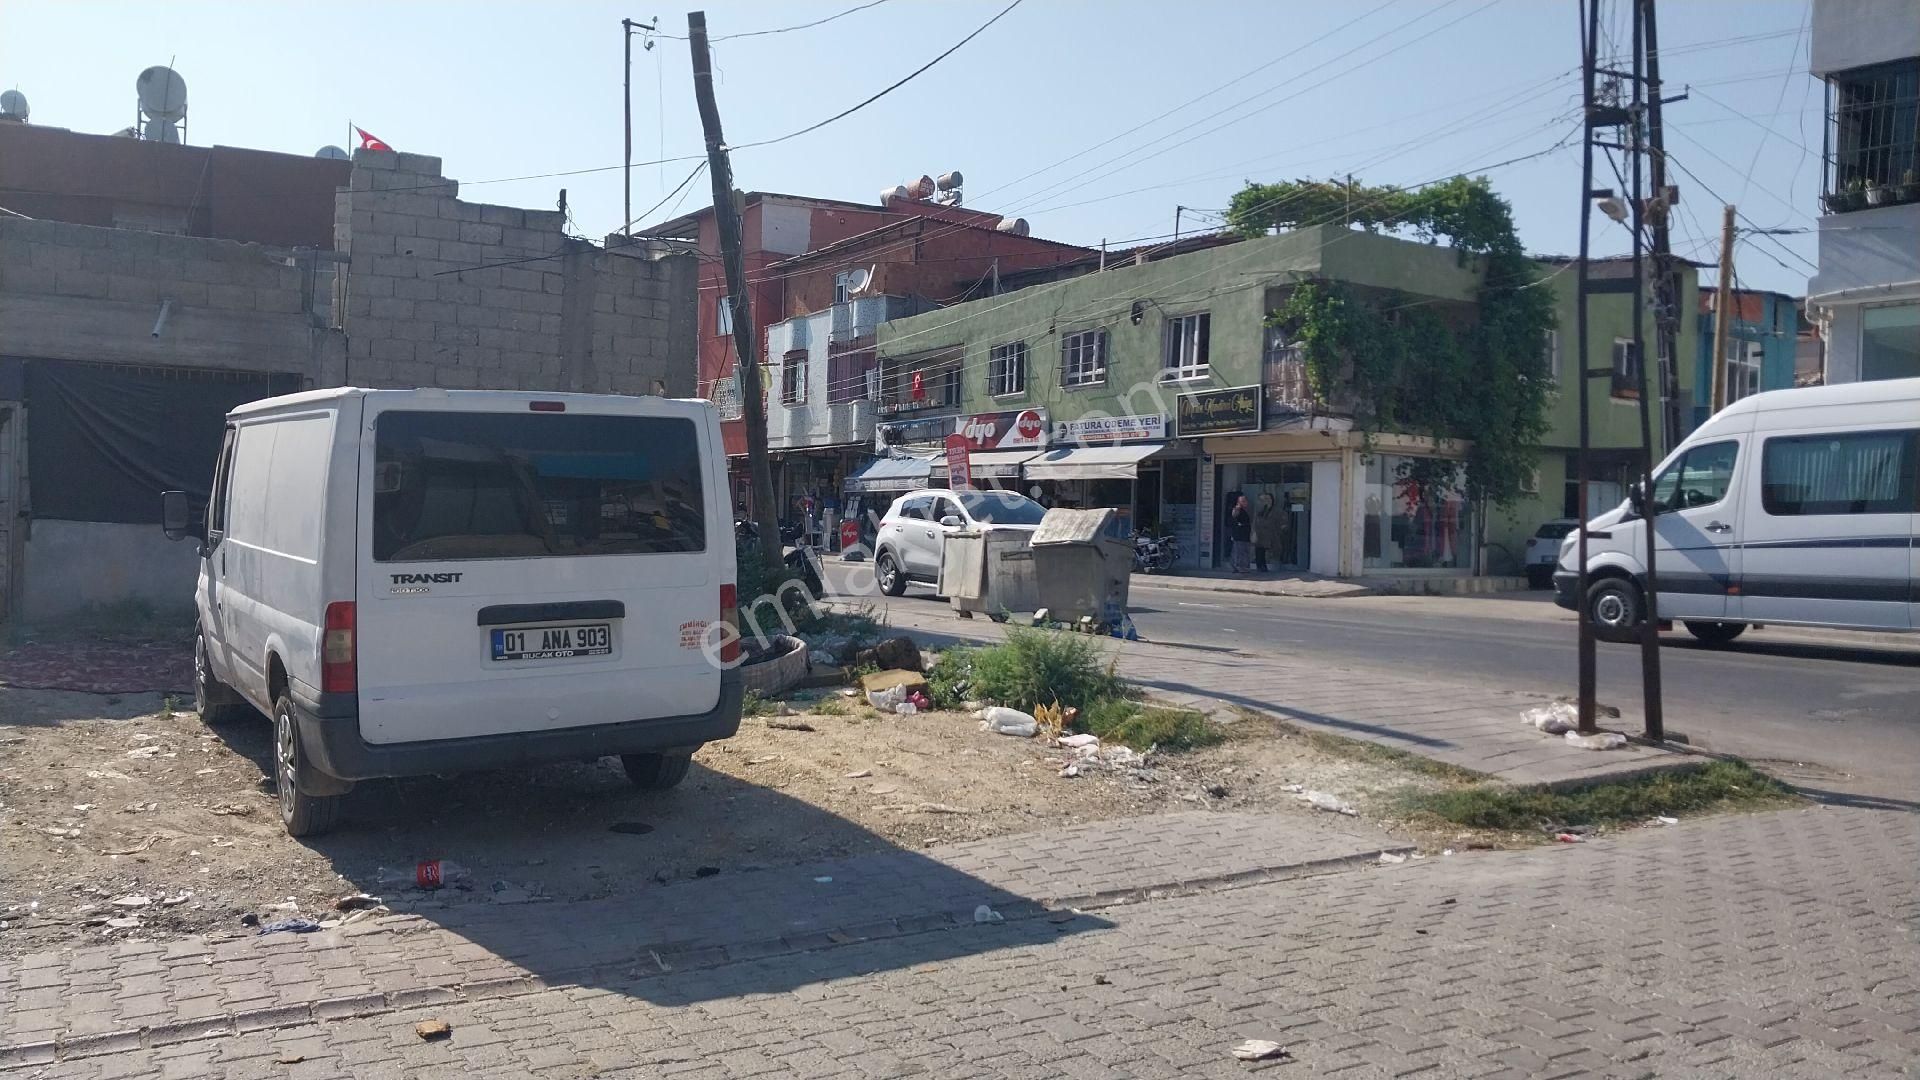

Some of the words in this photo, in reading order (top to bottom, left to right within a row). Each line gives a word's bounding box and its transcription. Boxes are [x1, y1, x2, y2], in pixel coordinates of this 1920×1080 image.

[1020, 416, 1041, 430] dyo
[1069, 420, 1101, 431] FATURA
[965, 418, 996, 444] dyo
[390, 572, 463, 584] TRANSIT
[505, 632, 525, 651] 01
[542, 630, 572, 650] ANA
[577, 628, 607, 647] 903
[522, 651, 553, 660] BUCAK
[555, 650, 574, 658] OTO
